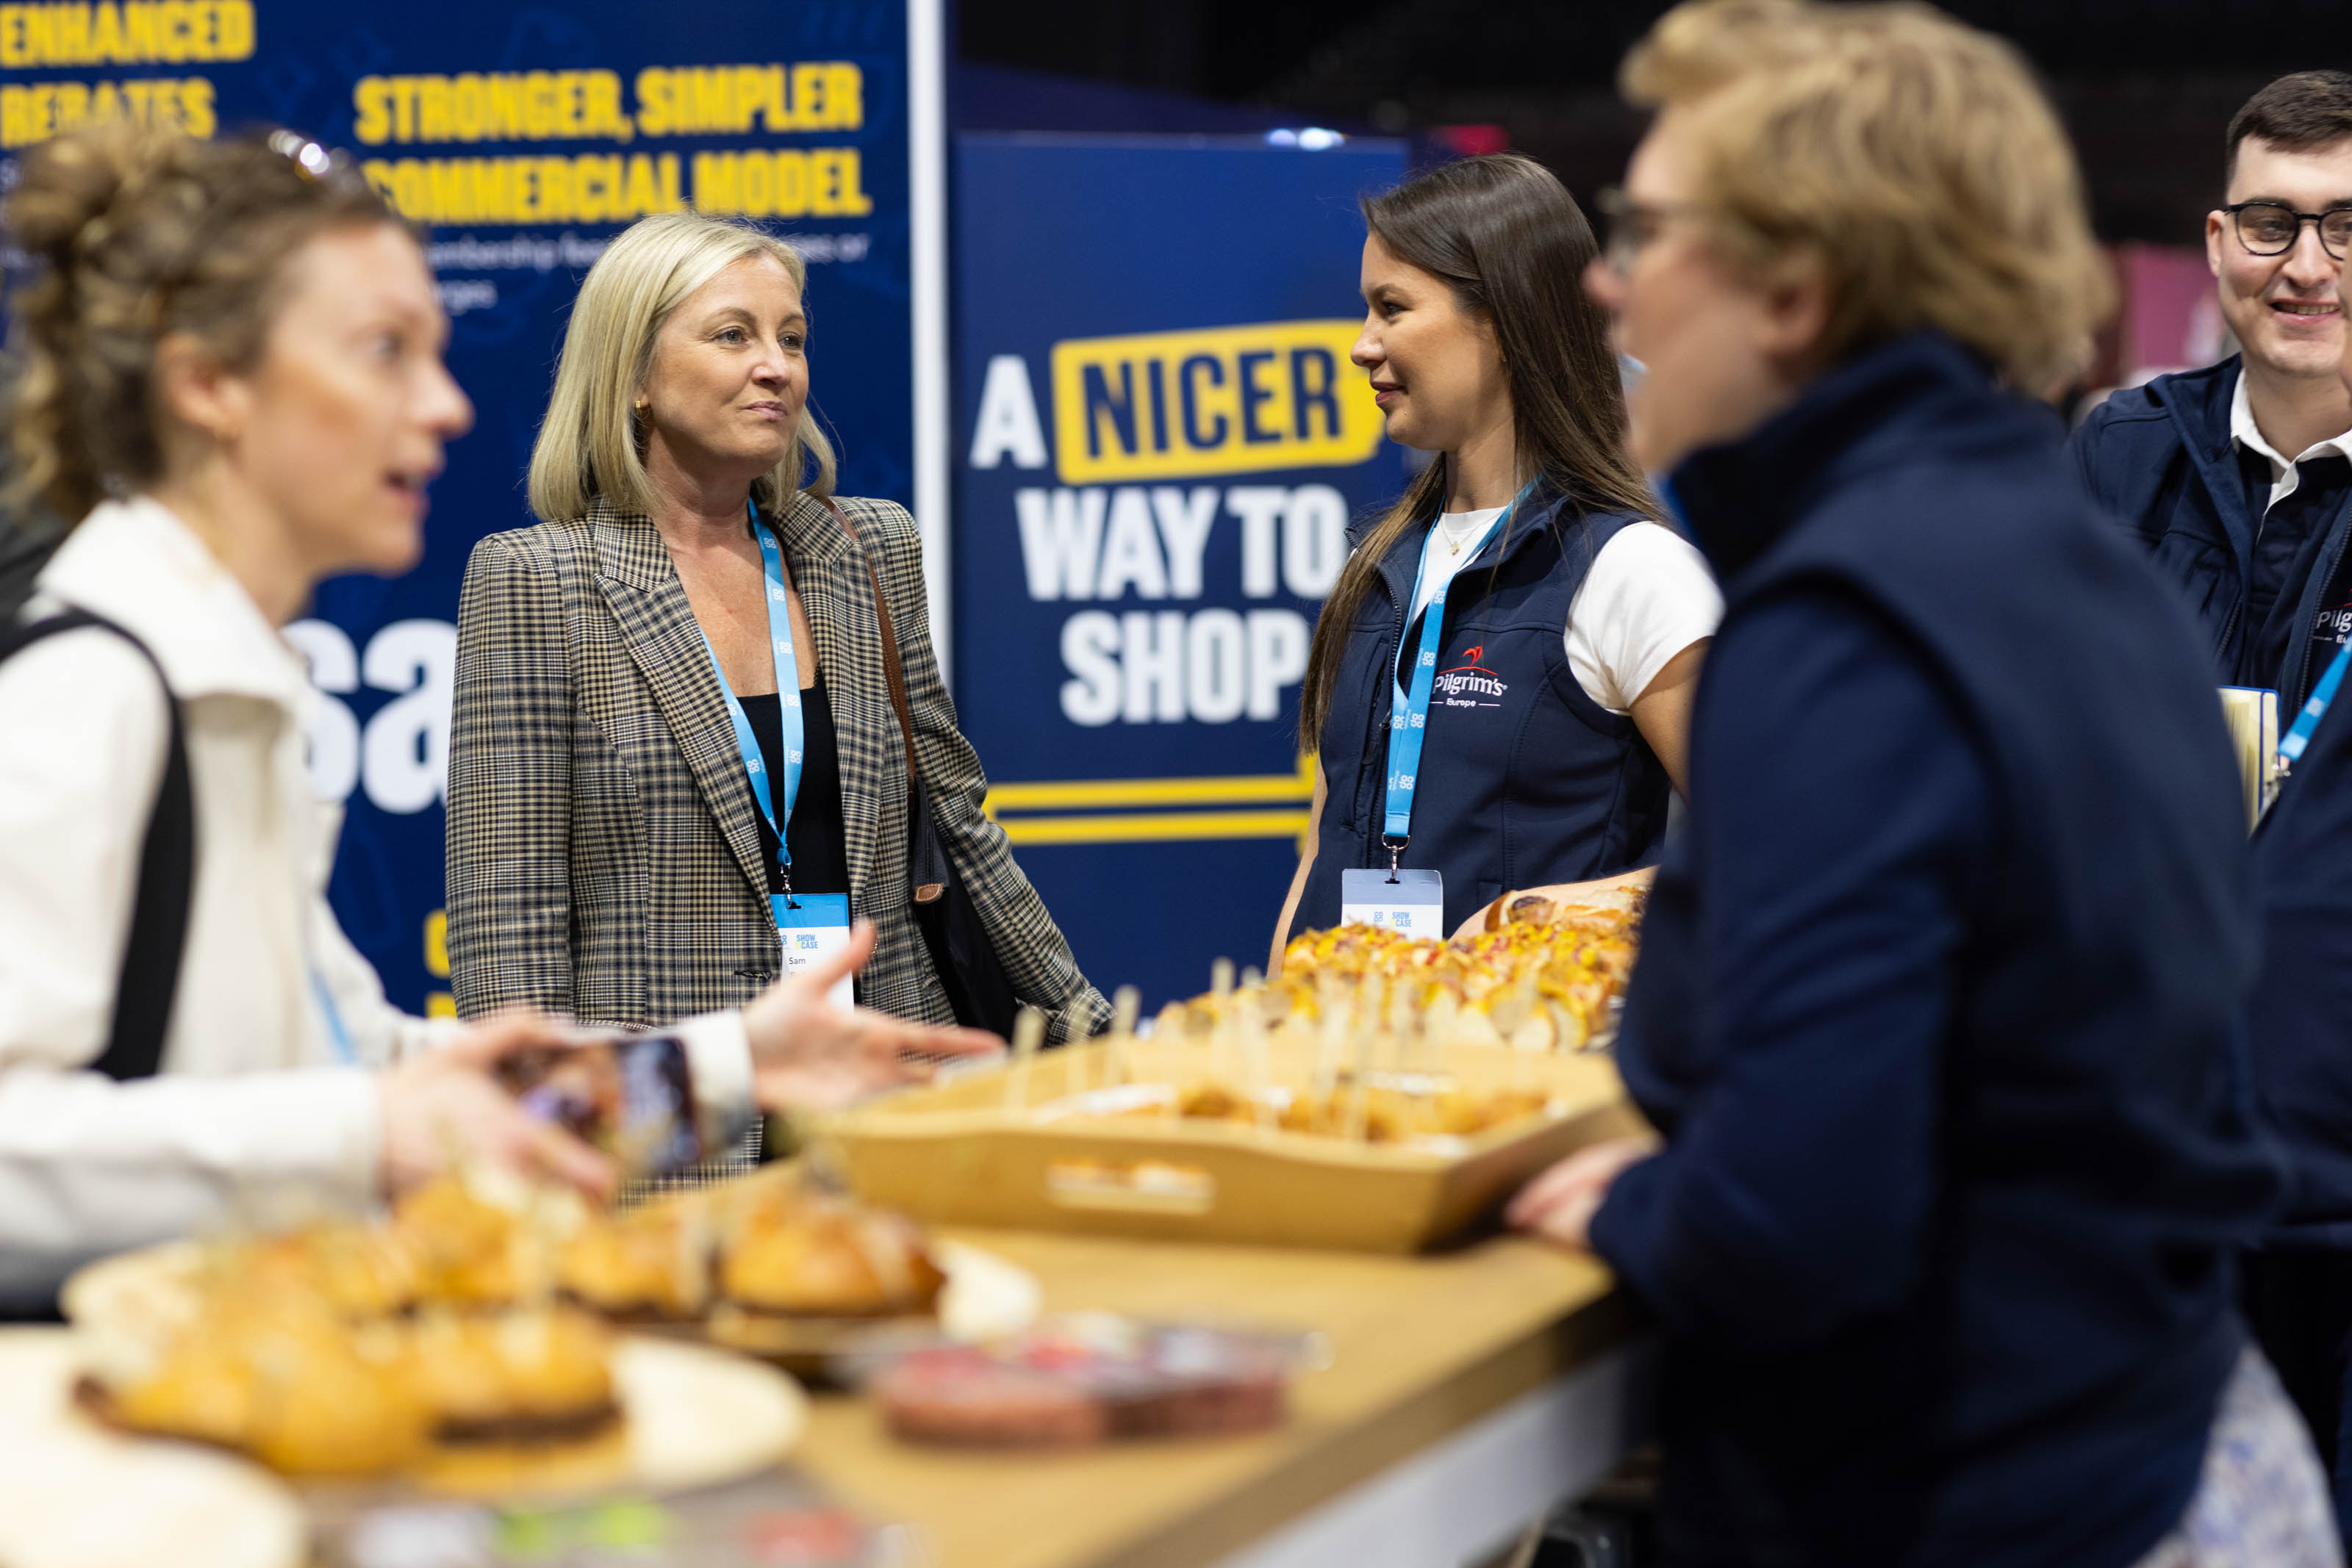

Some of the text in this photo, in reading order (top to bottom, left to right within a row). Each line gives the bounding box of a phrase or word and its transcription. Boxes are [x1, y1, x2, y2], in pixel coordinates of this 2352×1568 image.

[0, 0, 256, 67] ENHANCED
[636, 62, 863, 137] SIMPLER
[970, 345, 1342, 470] A NICER
[1014, 482, 1348, 602] WAY TO
[1059, 608, 1310, 727] SHOP
[1446, 698, 1476, 708] Europe
[1396, 919, 1411, 927] CASE
